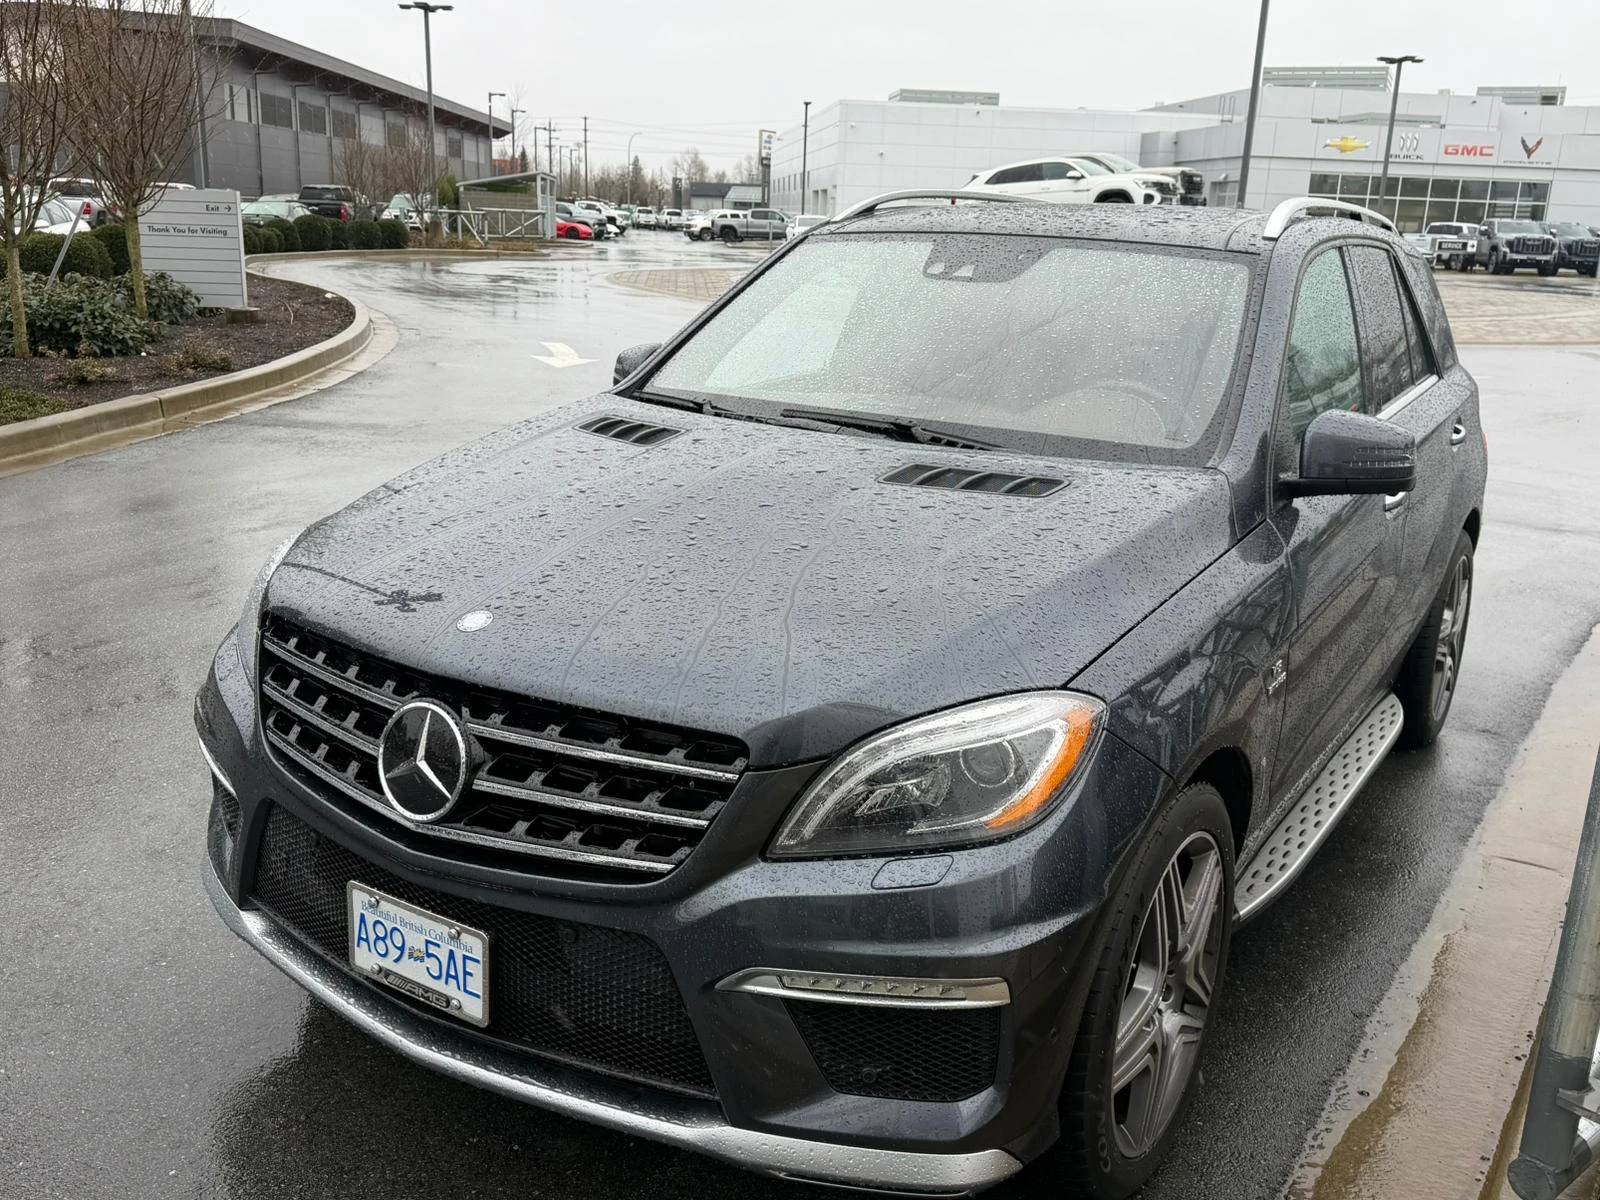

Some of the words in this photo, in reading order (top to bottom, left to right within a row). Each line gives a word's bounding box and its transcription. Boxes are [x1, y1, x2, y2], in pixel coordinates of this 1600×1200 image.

[1443, 144, 1494, 157] GMC
[205, 204, 220, 212] Exit
[147, 225, 170, 233] Thank
[172, 226, 186, 234] You
[187, 226, 198, 235] for
[200, 227, 228, 236] Visiting
[399, 916, 429, 937] British
[356, 912, 406, 963] A89
[424, 939, 481, 1000] 5AE
[405, 984, 448, 1007] AMG
